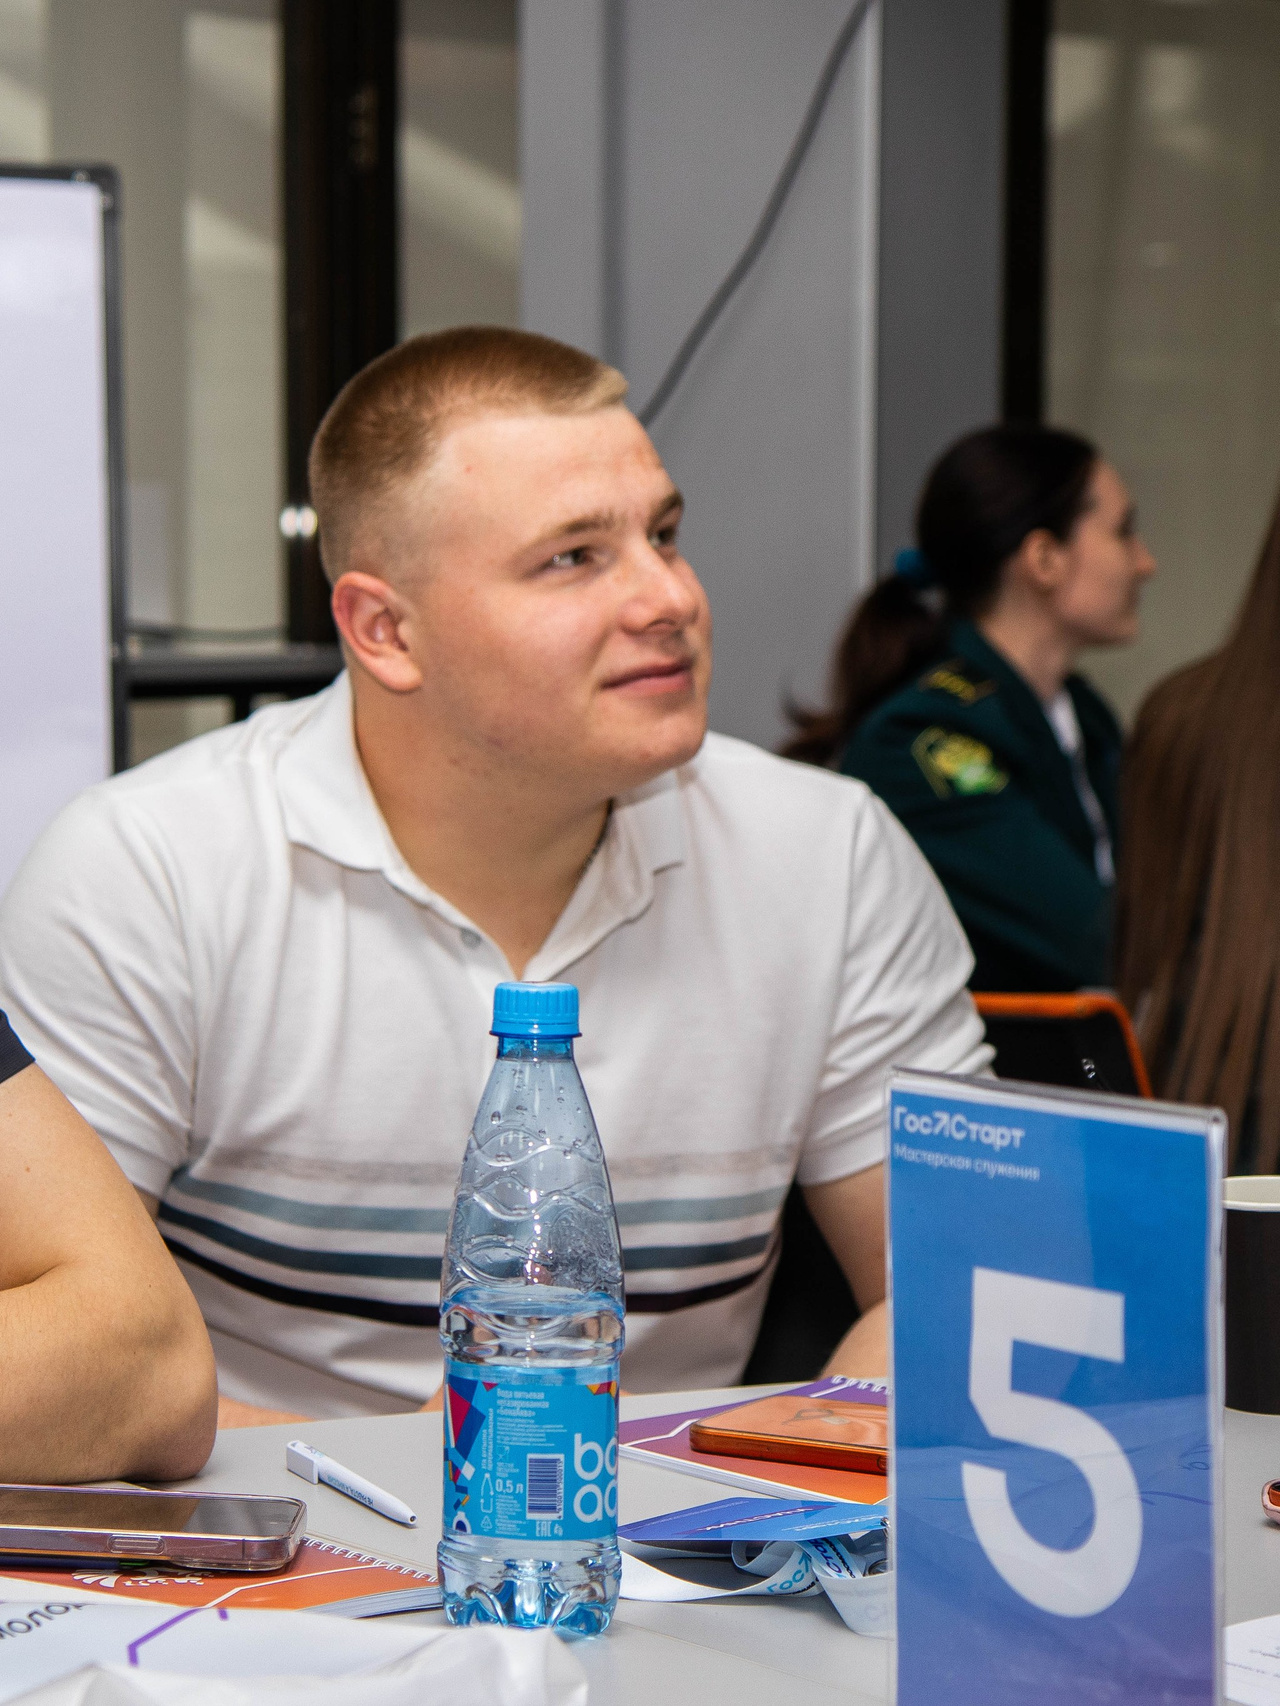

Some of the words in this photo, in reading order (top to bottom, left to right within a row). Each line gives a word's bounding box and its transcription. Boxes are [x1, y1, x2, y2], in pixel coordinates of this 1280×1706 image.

[894, 1143, 972, 1170] Мастерская
[973, 1157, 1041, 1181] служения
[962, 1266, 1143, 1618] 5
